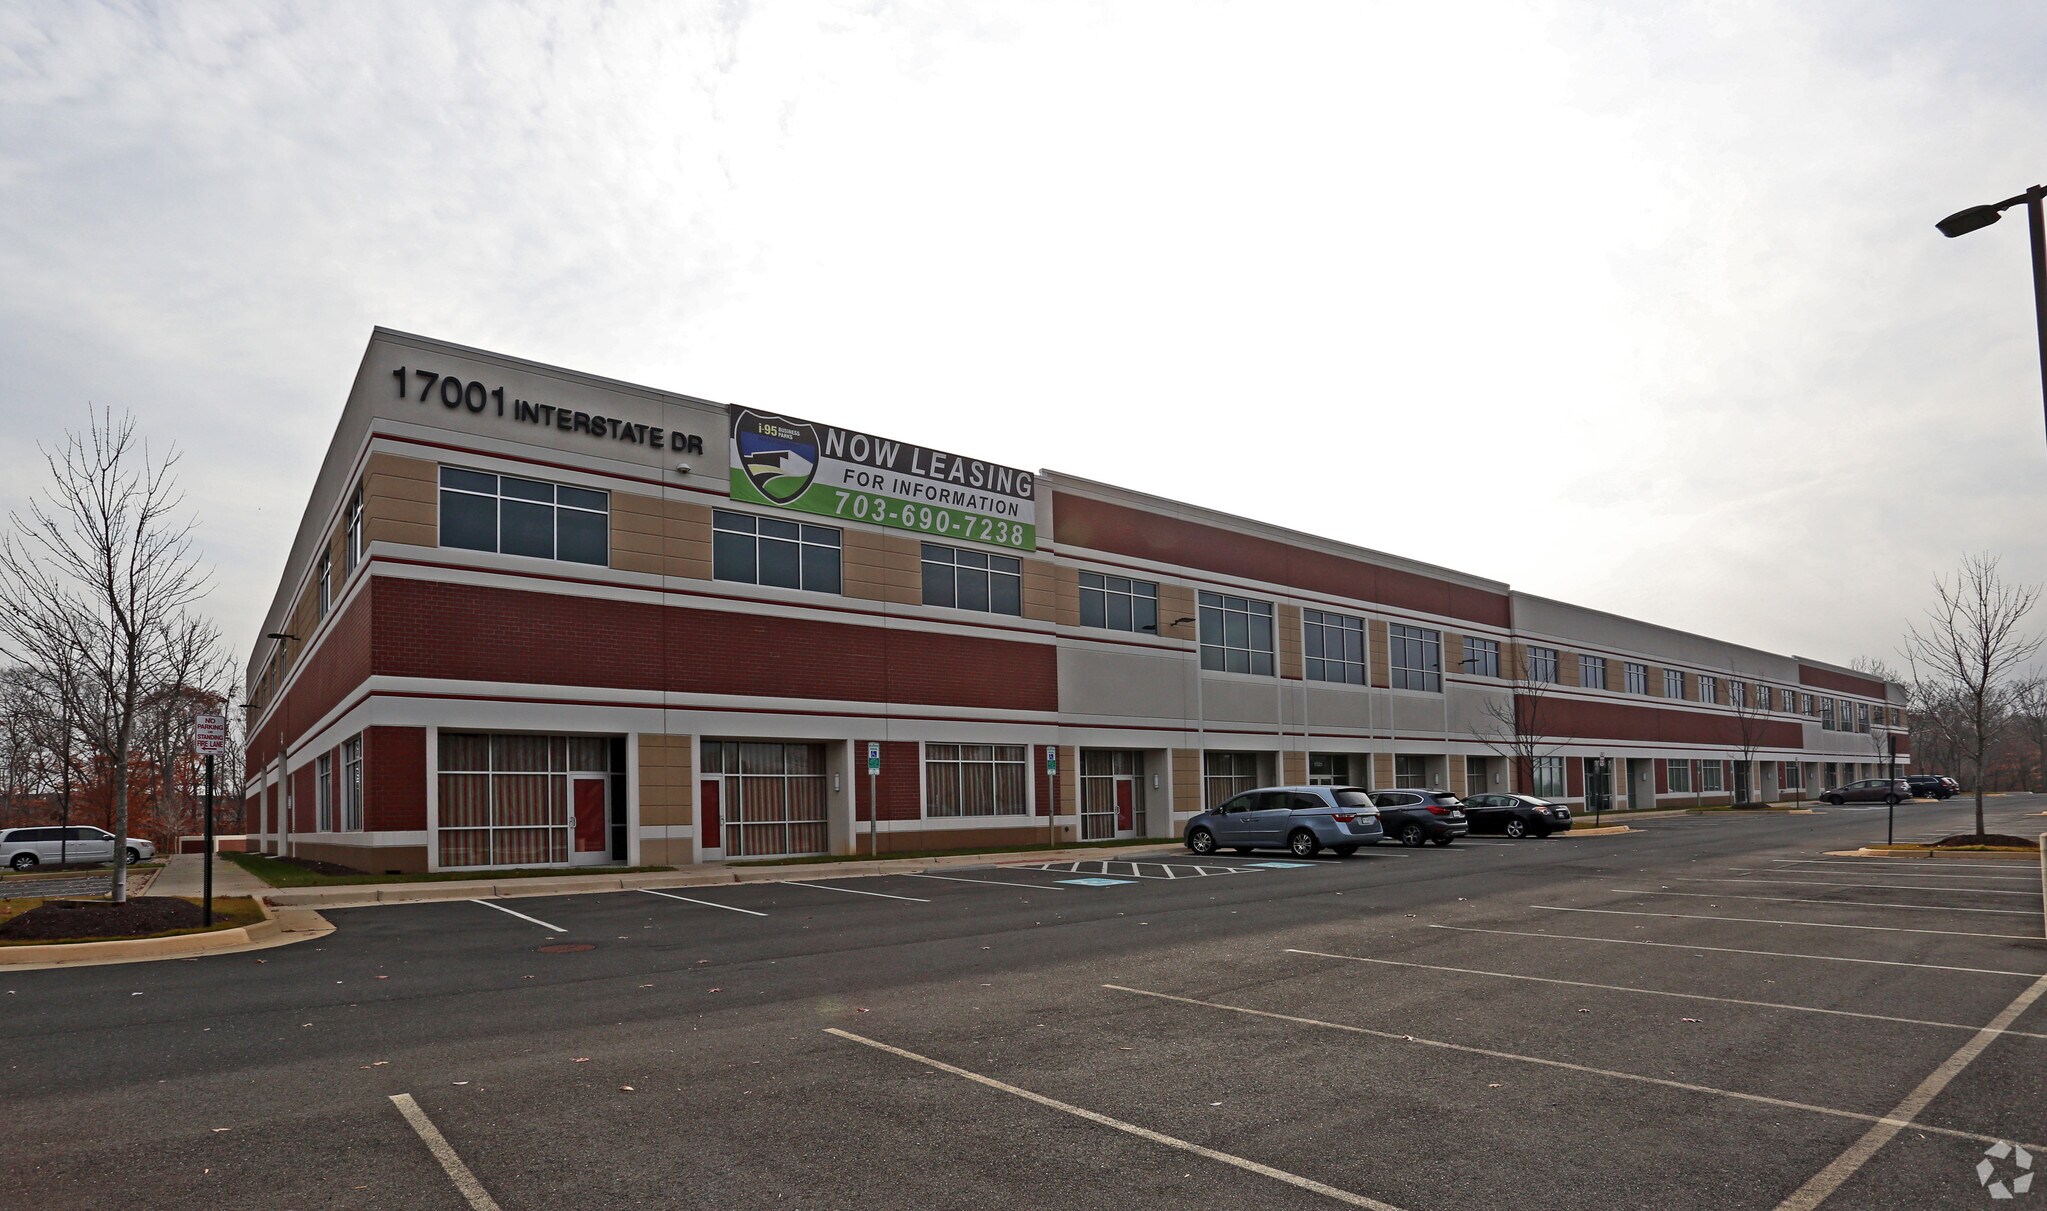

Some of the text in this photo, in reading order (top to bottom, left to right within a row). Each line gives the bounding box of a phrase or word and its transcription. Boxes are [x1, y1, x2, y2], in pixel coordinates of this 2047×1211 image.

[393, 366, 703, 455] 17001 INTERSTATE DR
[758, 423, 777, 436] i-95
[778, 427, 800, 436] BUSINESS
[825, 428, 1032, 497] NOW LEASING
[835, 491, 1024, 546] 703-690-7238
[843, 469, 1019, 517] FOR INFORMATION
